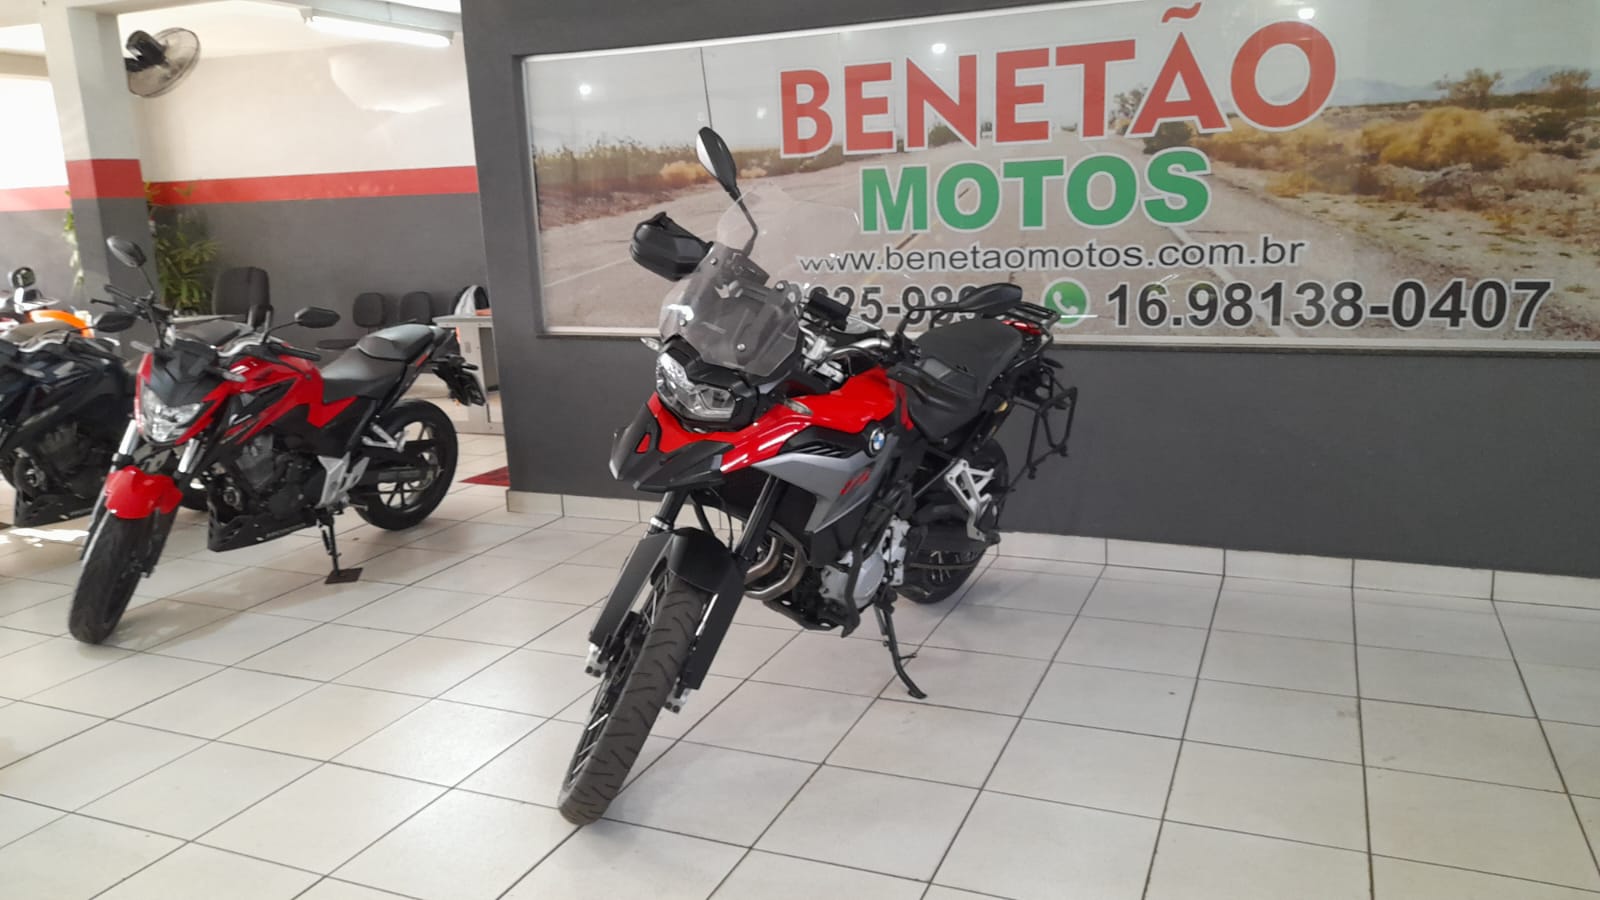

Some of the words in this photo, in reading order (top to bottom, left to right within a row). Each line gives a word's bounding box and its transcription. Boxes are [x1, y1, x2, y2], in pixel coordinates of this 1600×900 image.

[780, 3, 1336, 156] BENETÃO
[861, 151, 1210, 231] MOTOS
[800, 237, 1304, 271] www.benetaomotos.com.br
[1107, 281, 1552, 329] 16.98138-0407
